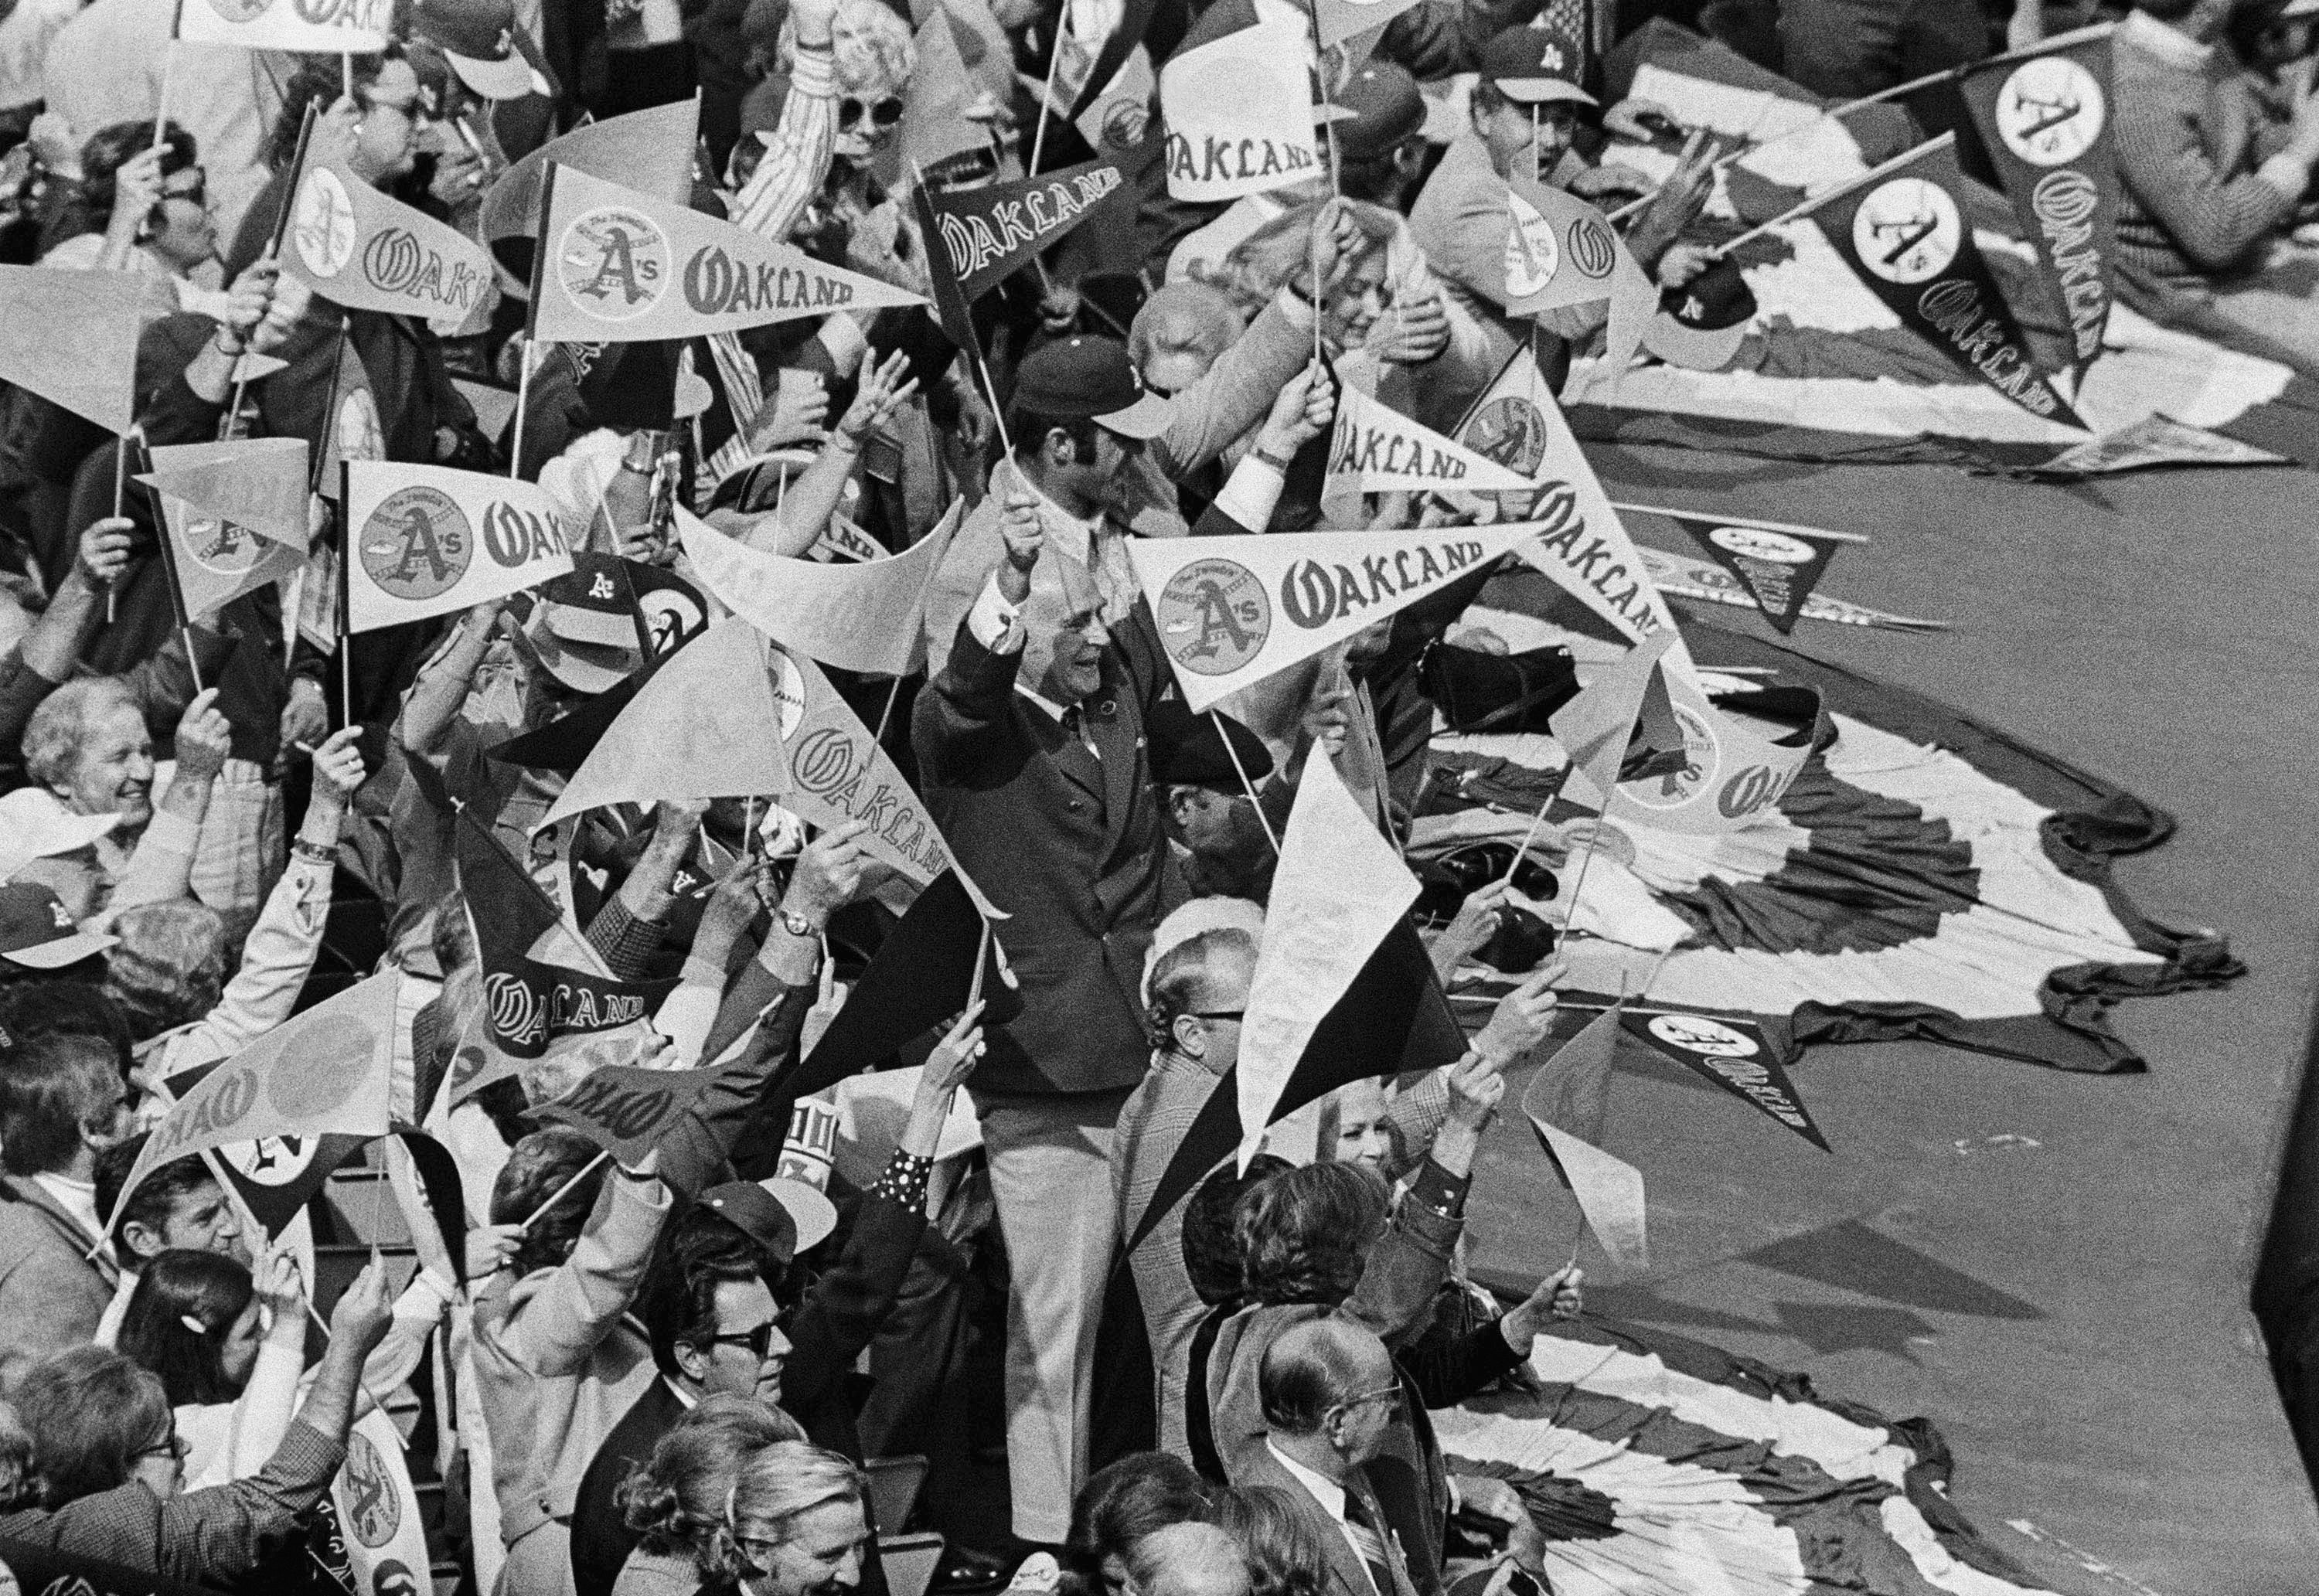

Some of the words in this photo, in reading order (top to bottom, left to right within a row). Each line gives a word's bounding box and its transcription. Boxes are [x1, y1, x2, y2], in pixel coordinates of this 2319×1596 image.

[578, 227, 658, 305] A's
[684, 244, 853, 315] OAKLAND
[386, 507, 462, 582] A's
[1530, 479, 1660, 638] OAKLAN
[1188, 580, 1259, 658] A's
[1280, 540, 1483, 629] OAKLAND
[485, 972, 644, 1045] OALAND
